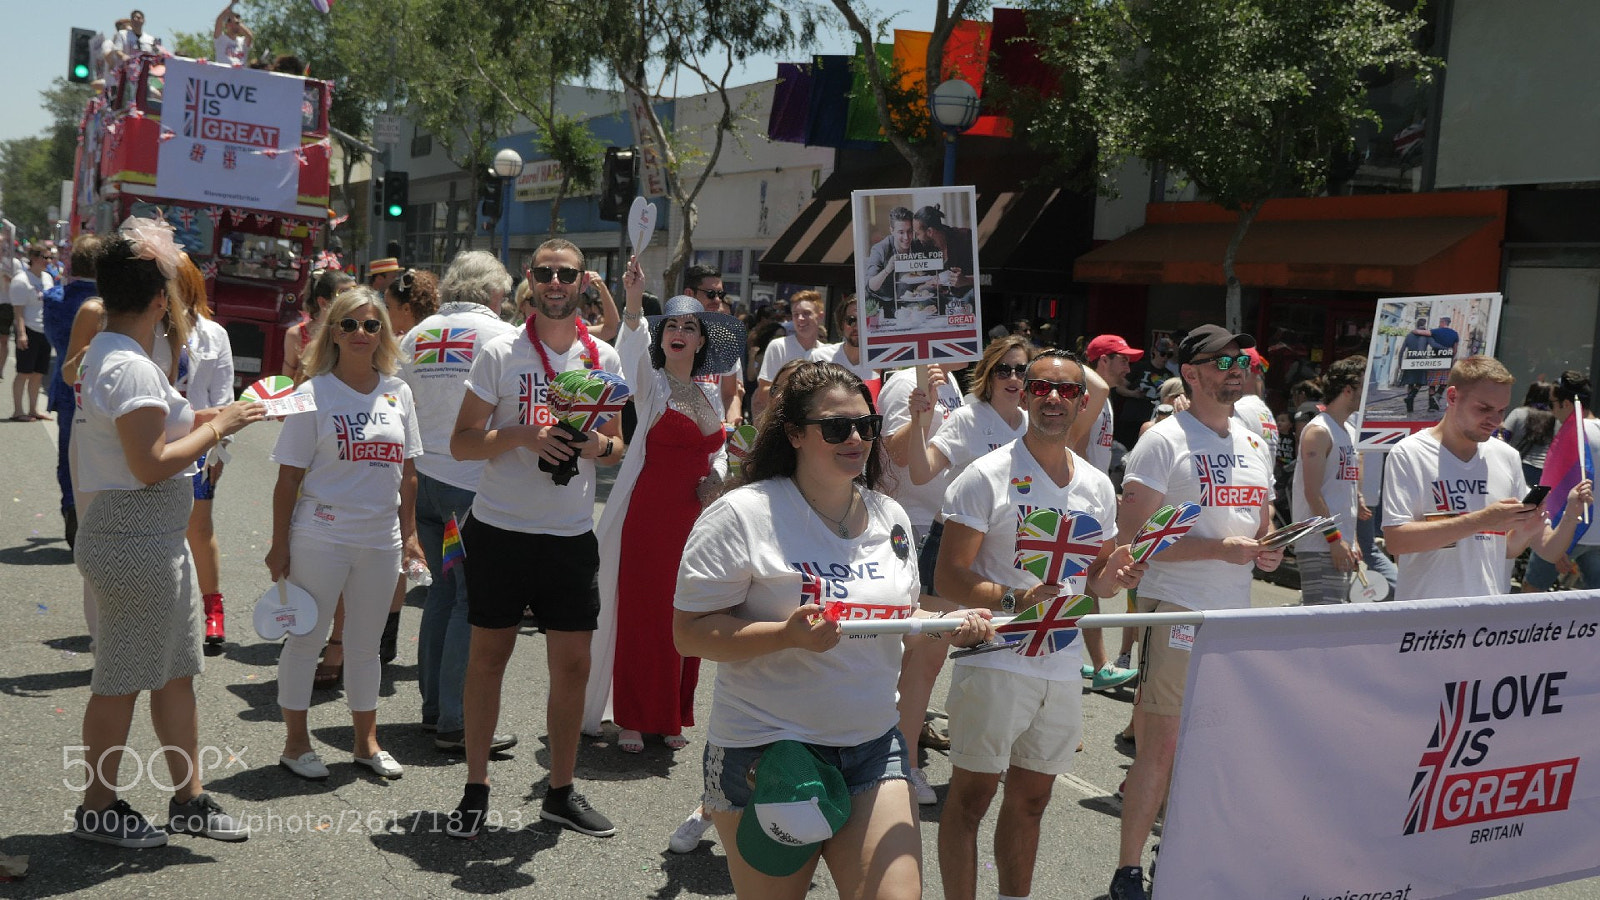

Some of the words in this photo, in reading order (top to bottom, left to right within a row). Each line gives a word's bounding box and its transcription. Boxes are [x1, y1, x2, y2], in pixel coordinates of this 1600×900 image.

[204, 80, 257, 103] LOVE
[202, 99, 220, 116] IS
[203, 120, 279, 146] GREAT
[900, 252, 927, 260] TRAVEL
[929, 251, 944, 259] FOR
[910, 261, 929, 269] LOVE
[948, 315, 974, 324] GREAT
[1408, 349, 1437, 357] TRAVEL
[1410, 360, 1442, 368] STORIES
[534, 388, 548, 403] IS
[346, 412, 390, 426] LOVE
[350, 427, 366, 441] IS
[354, 444, 403, 460] GREAT
[1208, 454, 1248, 468] LOVE
[1211, 469, 1226, 484] IS
[1446, 479, 1489, 495] LOVE
[1217, 488, 1266, 504] GREAT
[1449, 495, 1467, 511] IS
[812, 561, 884, 580] LOVE
[825, 578, 849, 599] IS
[839, 607, 910, 621] REAT
[1399, 628, 1466, 653] British
[1472, 621, 1562, 648] Consulate
[1566, 619, 1598, 640] Los
[1469, 671, 1568, 724] LOVE
[1449, 727, 1495, 769] IS
[1442, 764, 1573, 821] GREAT
[1469, 822, 1524, 844] BRITAIN
